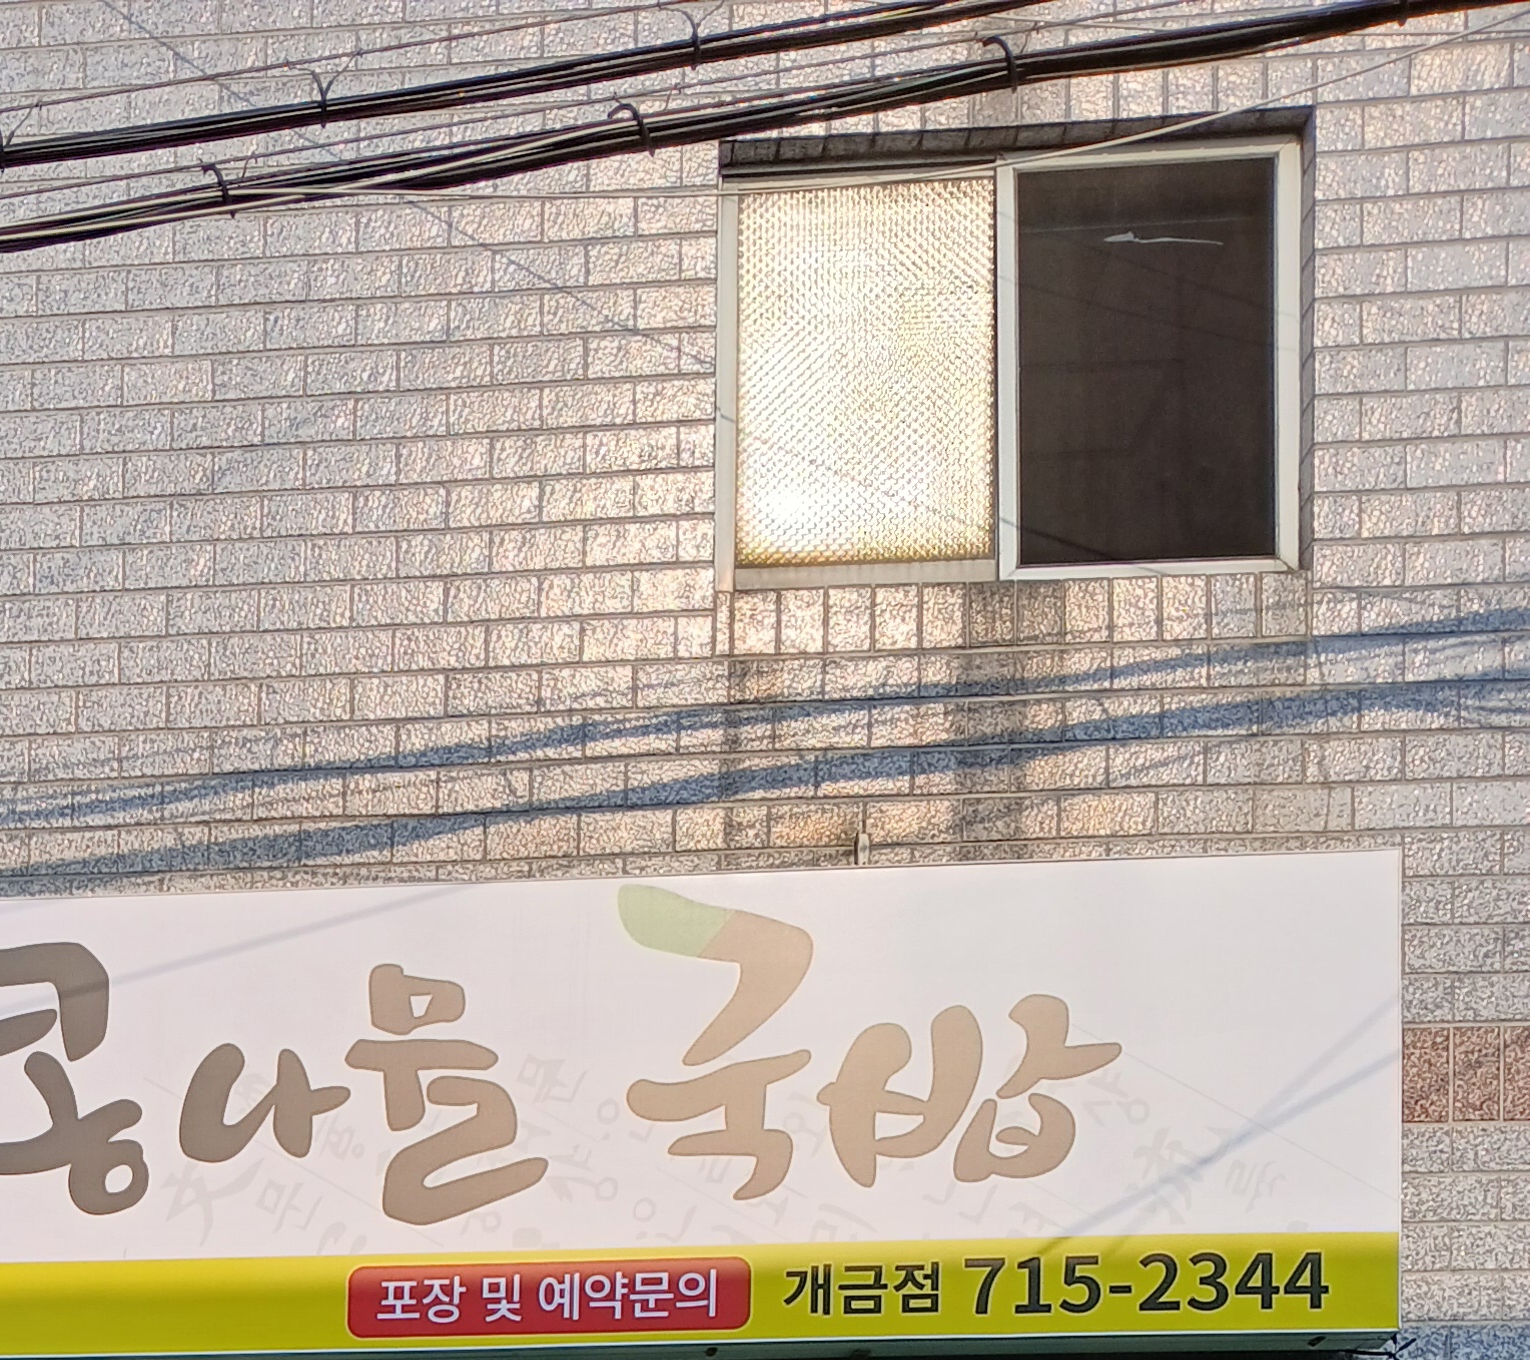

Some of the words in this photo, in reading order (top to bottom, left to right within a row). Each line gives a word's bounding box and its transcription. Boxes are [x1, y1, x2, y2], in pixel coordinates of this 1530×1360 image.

[617, 884, 1123, 1201] 국밥
[375, 1275, 466, 1323] 포장
[479, 1272, 525, 1322] 및
[536, 1267, 720, 1319] 예약문의
[782, 1260, 943, 1318] 개금점
[962, 1250, 1330, 1316] 715-2344
